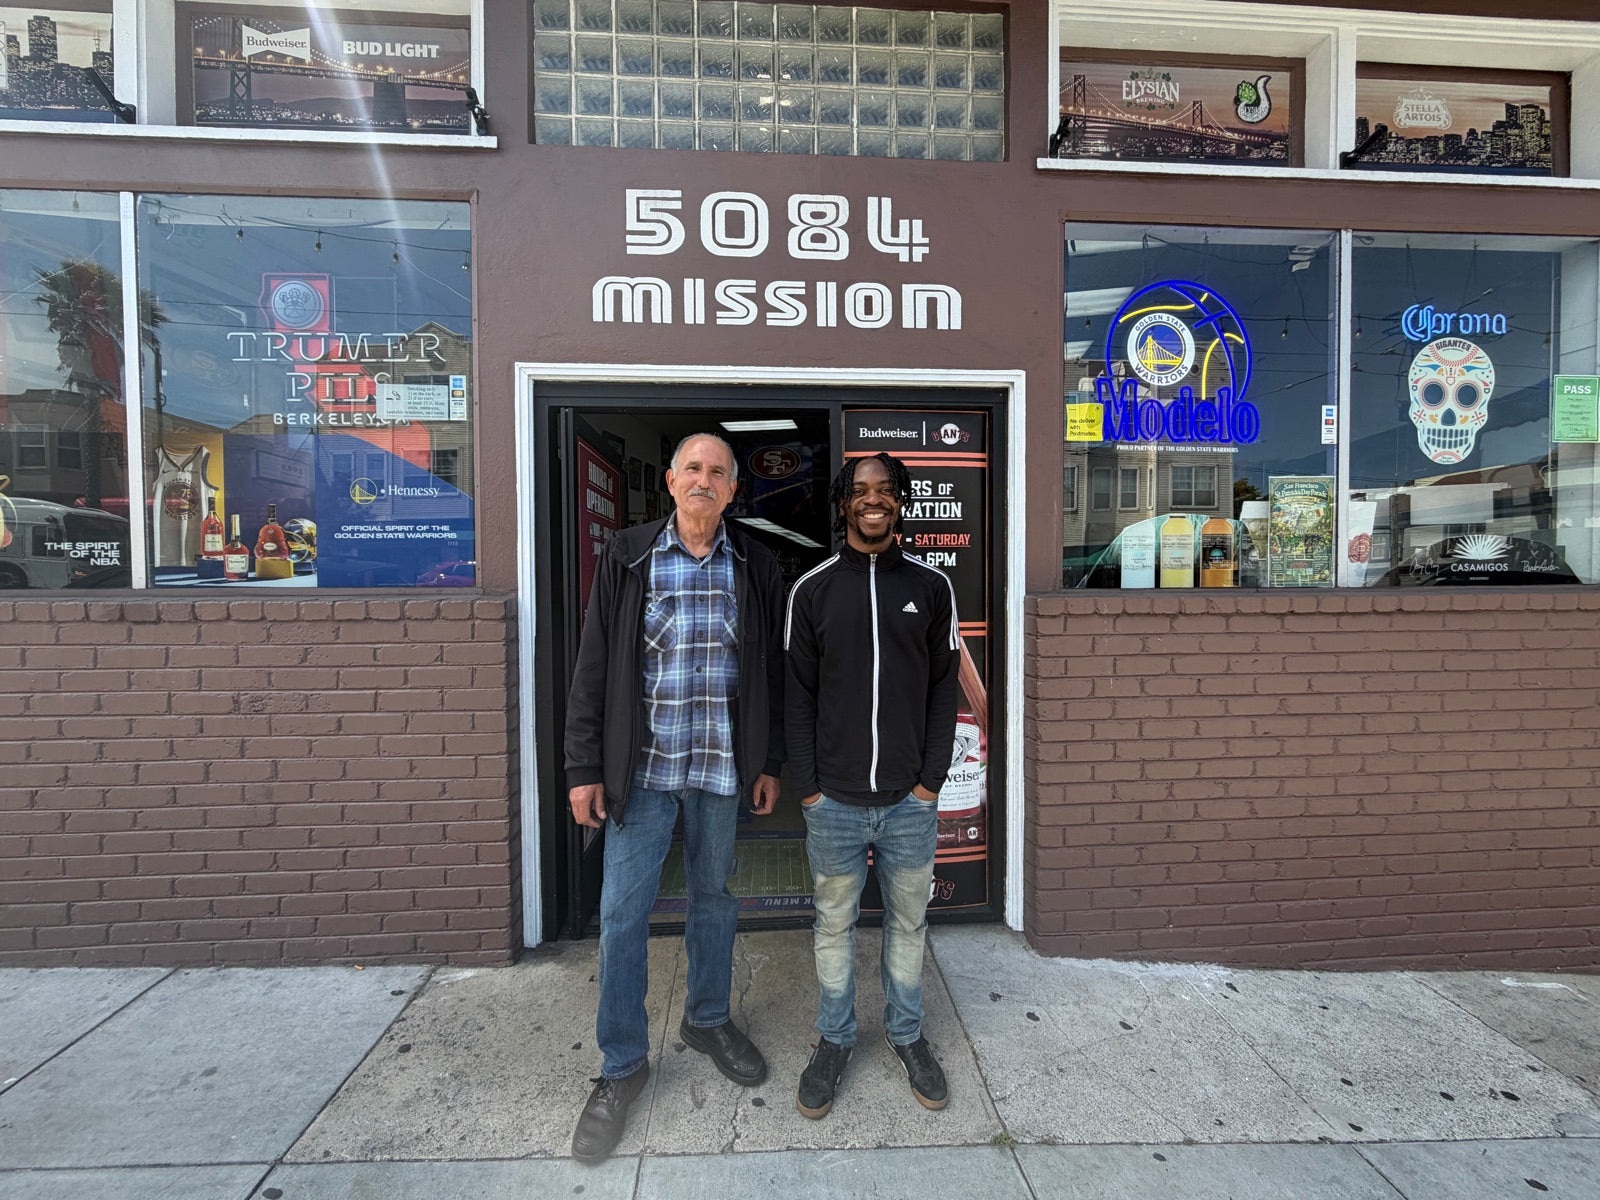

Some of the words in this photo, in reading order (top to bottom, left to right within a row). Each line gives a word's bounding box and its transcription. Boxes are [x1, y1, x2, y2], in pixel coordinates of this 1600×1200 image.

[343, 40, 383, 56] BUD
[386, 42, 440, 58] LIGHT
[1122, 80, 1179, 102] ELYSIAN
[1404, 104, 1440, 113] STELLA
[1404, 112, 1442, 122] ARTOIS
[626, 188, 930, 262] 5084
[1135, 314, 1163, 332] GOLDEN
[1166, 316, 1186, 333] STATE
[1401, 304, 1508, 342] Corona
[226, 332, 446, 362] TRUMER
[1435, 340, 1472, 352] GIGANTES
[1135, 363, 1188, 384] WARRIORS
[1564, 385, 1592, 394] PASS
[1095, 378, 1260, 444] Modelo
[388, 484, 440, 498] Hennessy
[938, 483, 954, 495] OF
[44, 542, 73, 550] THE
[915, 534, 971, 545] SATURDAY
[926, 552, 956, 566] 6PM
[1450, 563, 1509, 572] CASAMIGOS
